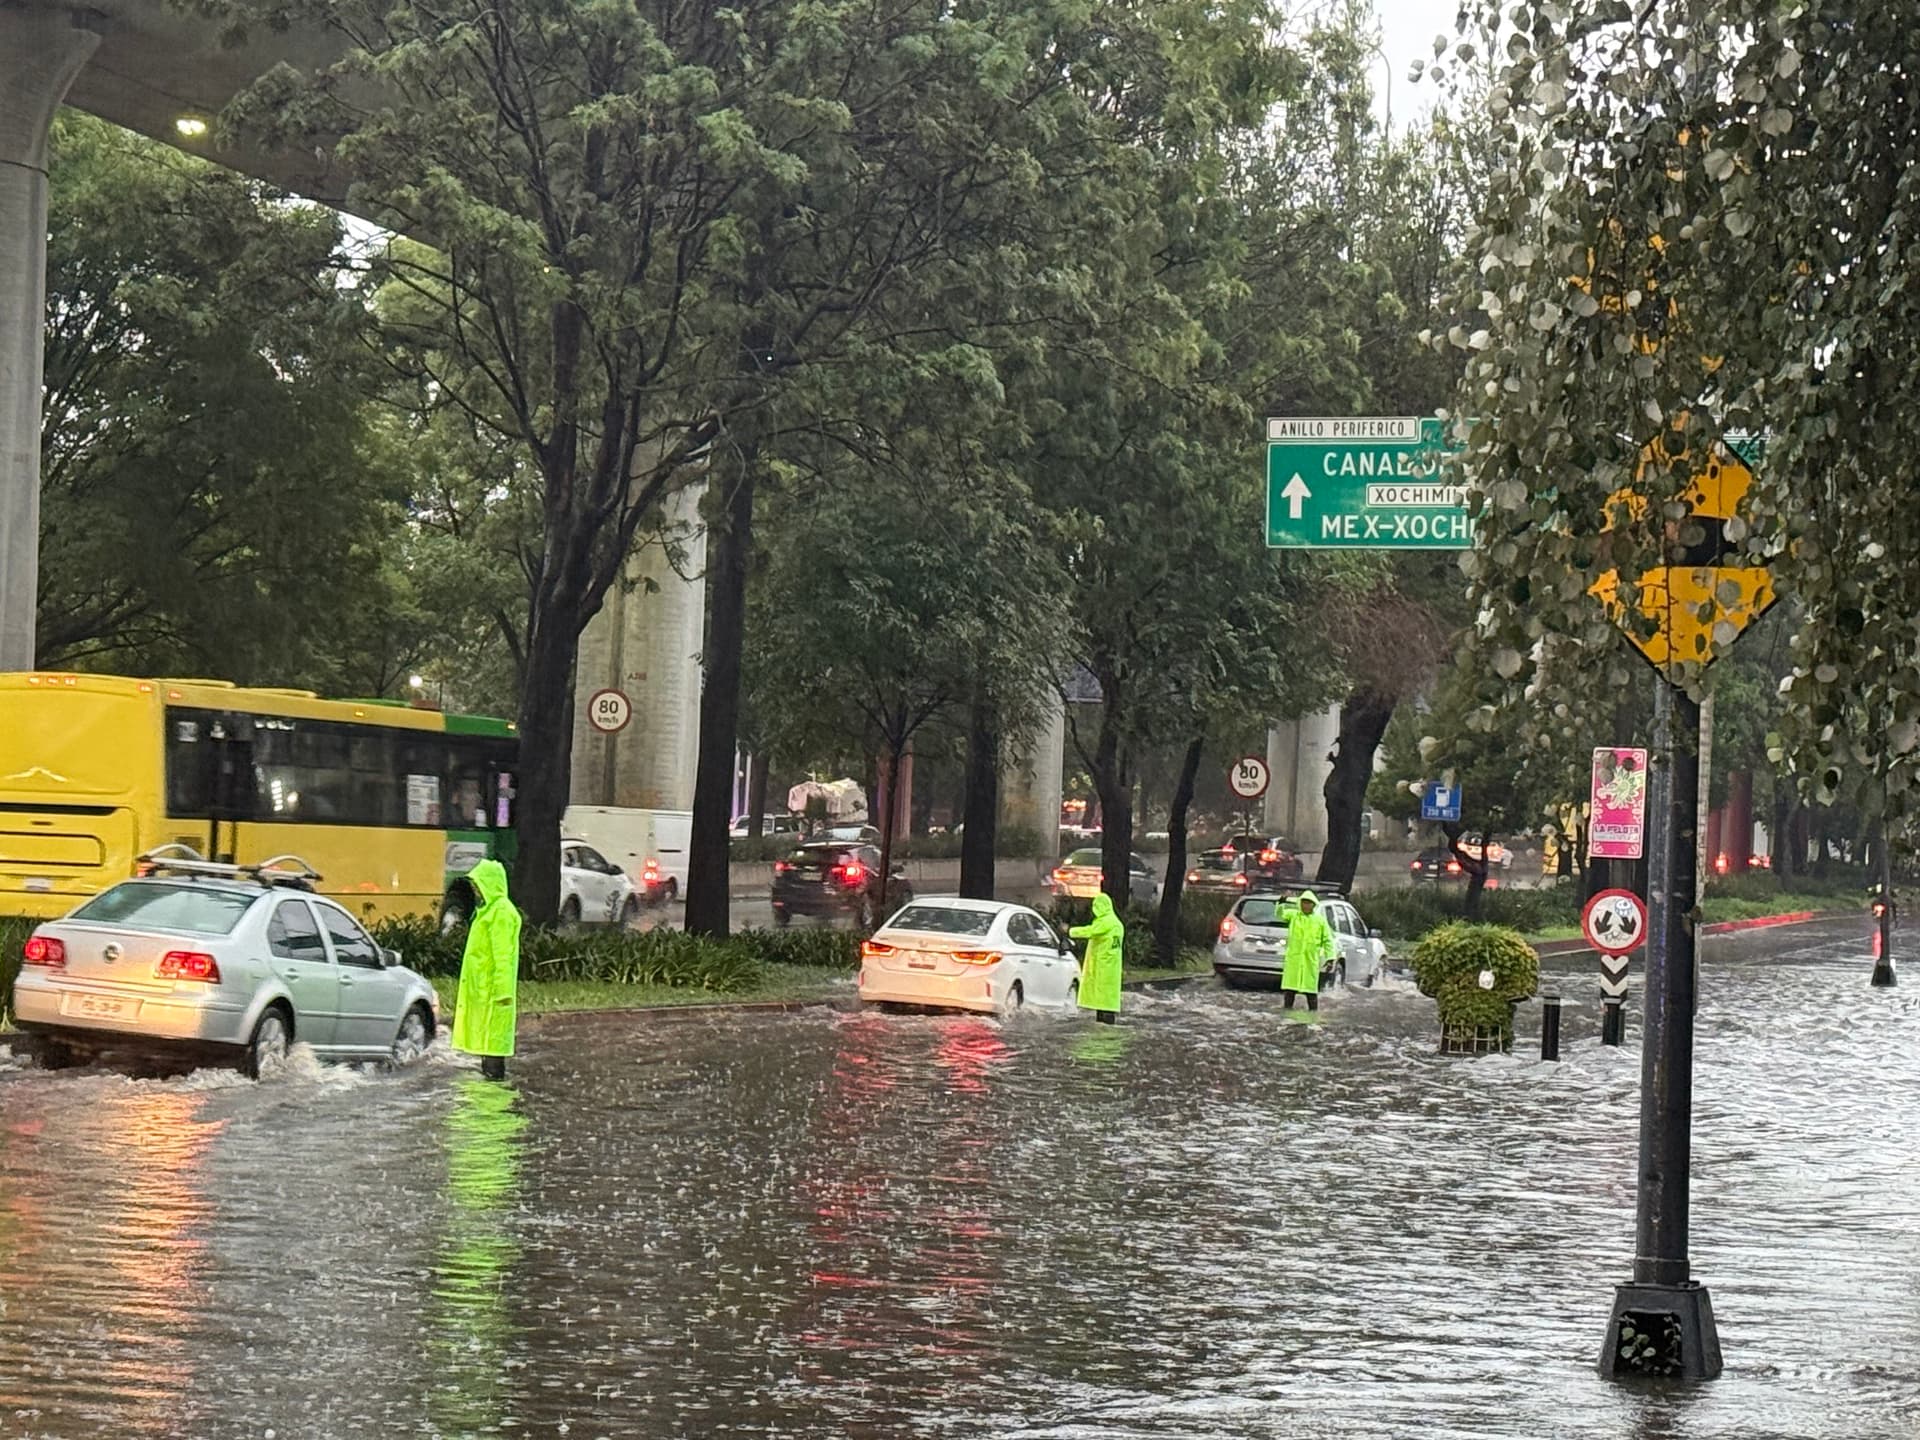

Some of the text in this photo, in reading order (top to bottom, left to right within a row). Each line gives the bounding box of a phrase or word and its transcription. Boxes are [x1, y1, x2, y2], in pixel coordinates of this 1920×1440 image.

[1280, 421, 1405, 436] ANILLO PERIFERICO
[1323, 452, 1411, 476] CANAL
[599, 700, 619, 714] 80
[1240, 766, 1259, 779] 80
